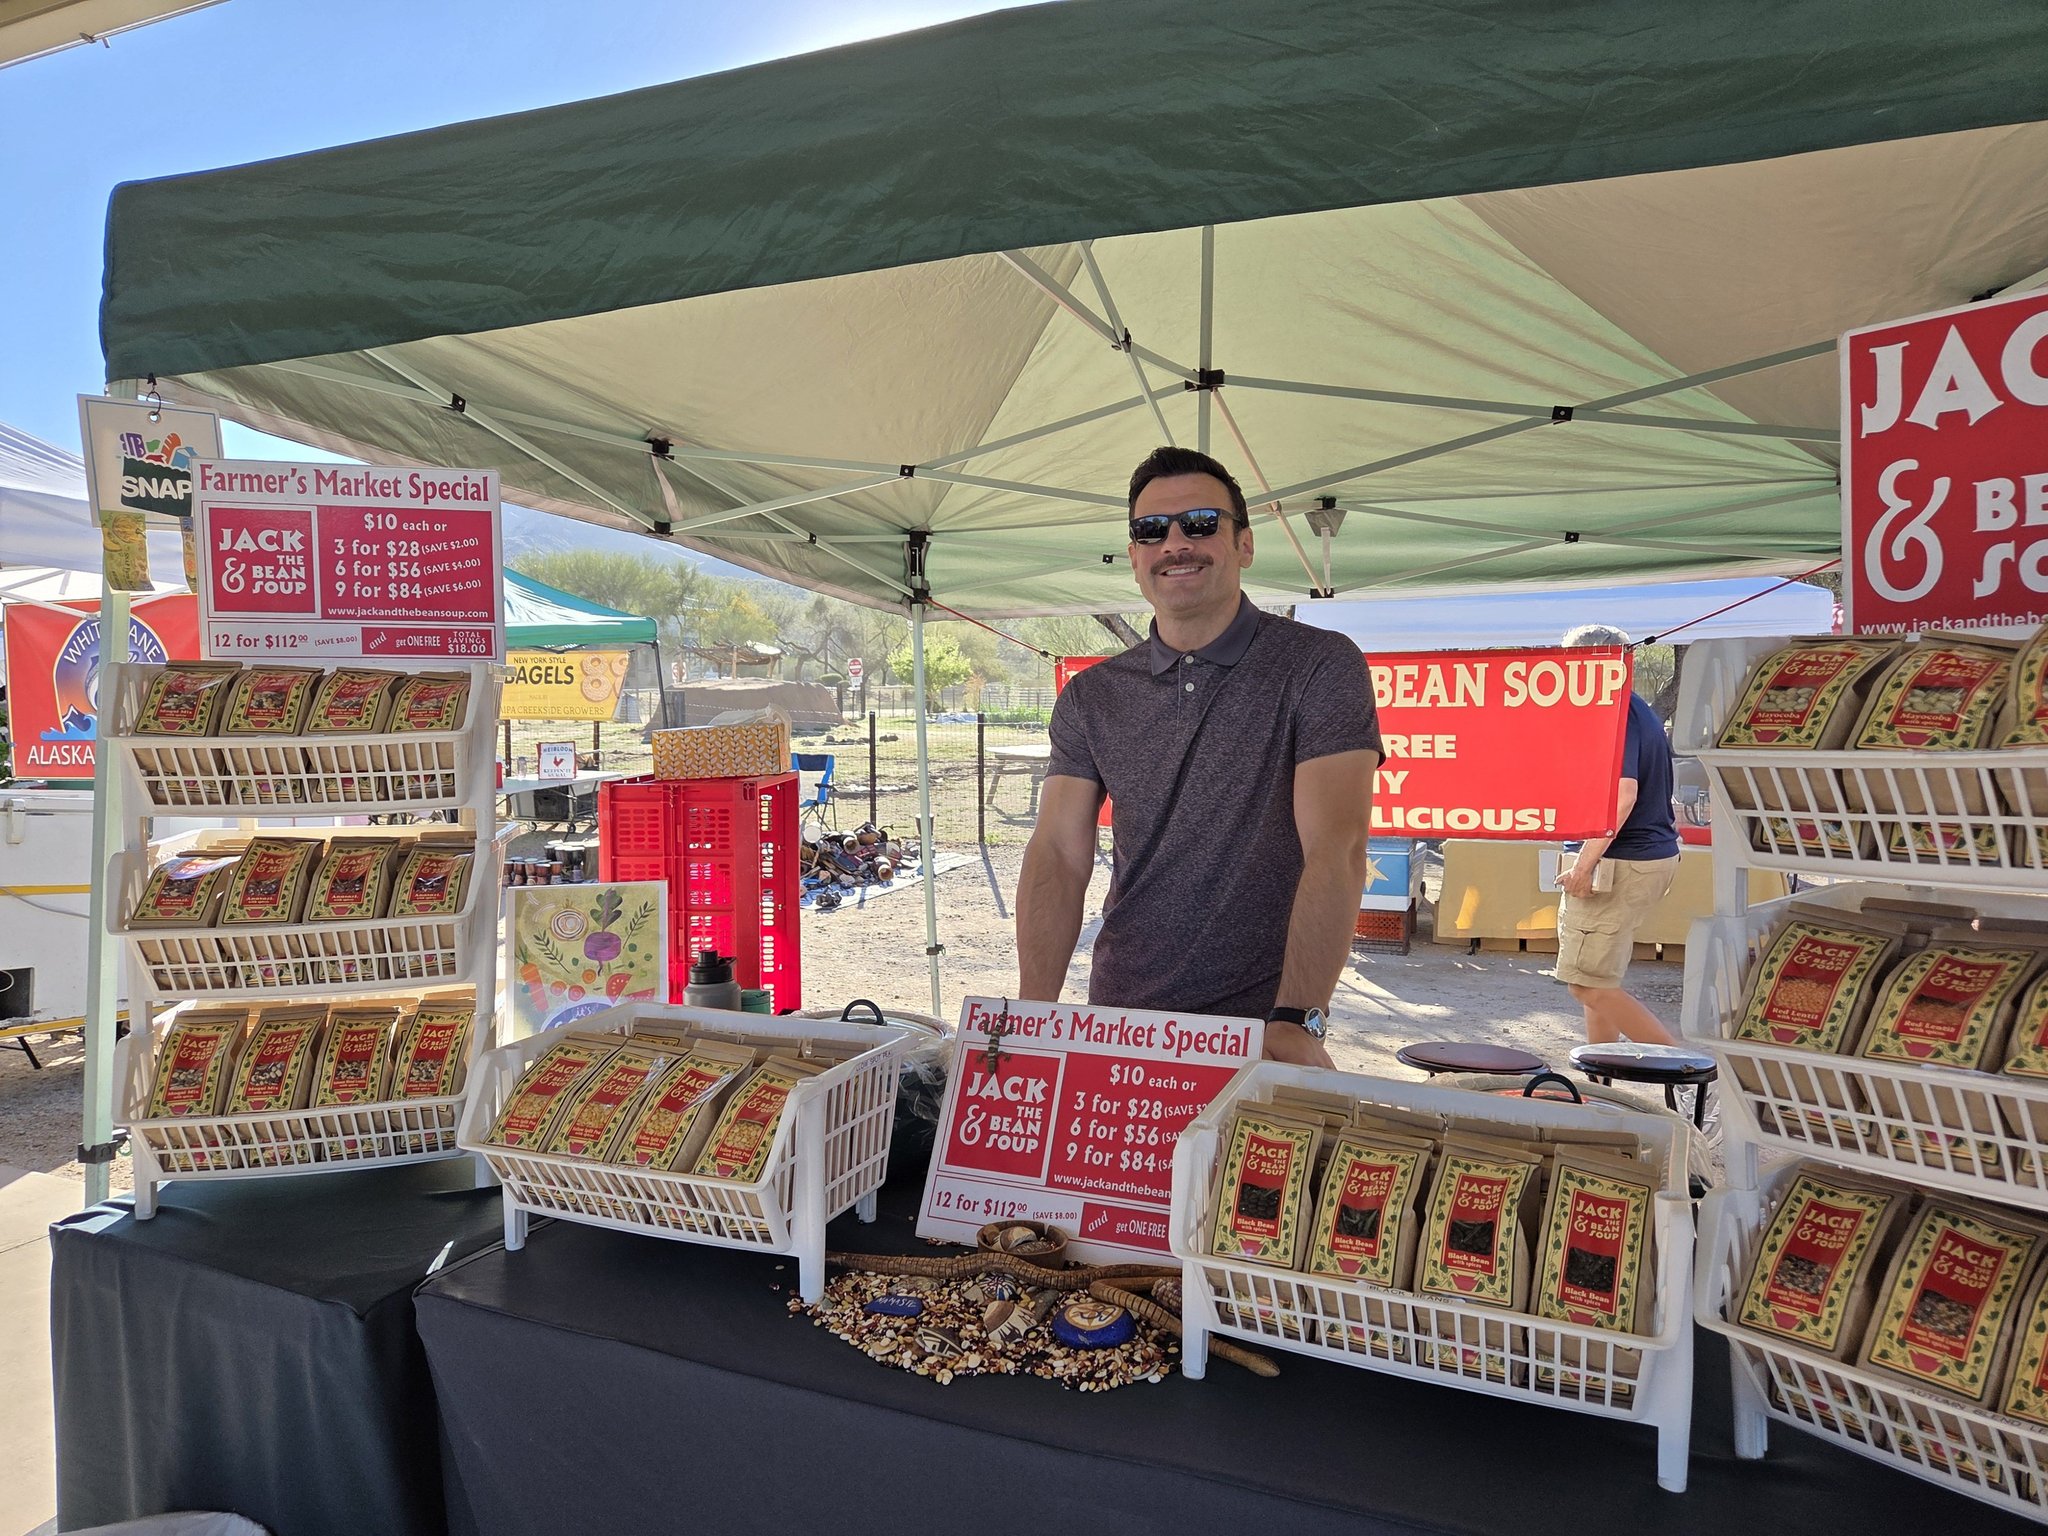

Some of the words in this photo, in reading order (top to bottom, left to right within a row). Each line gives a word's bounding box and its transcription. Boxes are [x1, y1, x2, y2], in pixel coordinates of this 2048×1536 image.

[122, 476, 192, 500] SNAP
[200, 464, 307, 494] Farmer's
[314, 469, 402, 499] Market
[408, 472, 489, 505] Special
[1972, 473, 2048, 533] BE
[364, 512, 398, 532] $10
[402, 520, 430, 532] each
[433, 523, 448, 532] or
[1865, 458, 1951, 602] &
[219, 528, 305, 553] JACK
[334, 538, 345, 555] 3
[352, 539, 380, 556] for
[386, 540, 420, 558] $28
[421, 542, 449, 555] (SAVE
[450, 537, 479, 550] $2.00)
[277, 555, 304, 565] THE
[221, 557, 246, 593] &
[252, 565, 305, 579] BEAN
[335, 560, 347, 576] 6
[353, 560, 381, 577] for
[387, 561, 421, 579] $56
[423, 563, 450, 576] (SAVE
[452, 558, 481, 571] $4.00)
[1972, 539, 2048, 600] SO
[252, 581, 307, 594] SOUP
[335, 581, 347, 597] 9
[353, 582, 381, 598] for
[388, 582, 422, 600] $84
[424, 584, 451, 597] (SAVE
[453, 579, 482, 592] $6.00)
[328, 606, 489, 618] www.jackandthebeansoup.com
[64, 621, 100, 664] WHIT
[129, 625, 161, 663] ANE
[215, 633, 231, 647] 12
[236, 634, 260, 648] for
[369, 631, 387, 650] and
[407, 635, 423, 646] ONE
[424, 636, 441, 647] FREE
[448, 644, 486, 654] $18.00
[514, 656, 528, 664] NEW
[1794, 653, 1847, 662] JACK
[1369, 663, 1489, 708] BEAN
[1503, 659, 1628, 708] SOUP
[563, 706, 605, 715] GROWERS
[1900, 713, 1952, 722] Mayocoba
[1380, 734, 1457, 759] REE
[1371, 806, 1558, 833] LICIOUS!
[1793, 952, 1812, 964] &
[1801, 942, 1854, 958] JACK
[1809, 963, 1843, 971] SOUP
[1939, 963, 1995, 978] JACK
[1772, 1007, 1789, 1015] Red
[1791, 1010, 1818, 1020] Lentil
[345, 1032, 375, 1042] JACK
[424, 1028, 453, 1038] JACK
[966, 1003, 1063, 1039] Farmer's
[1068, 1011, 1157, 1049] Market
[1162, 1018, 1251, 1058] Special
[551, 1063, 581, 1074] JACK
[1109, 1064, 1144, 1086] $10
[1149, 1076, 1177, 1089] each
[1182, 1081, 1197, 1091] or
[967, 1072, 1048, 1103] JACK
[1017, 1106, 1043, 1119] THE
[1074, 1091, 1086, 1110] 3
[1091, 1094, 1120, 1114] for
[1127, 1098, 1162, 1119] $28
[1164, 1105, 1194, 1118] (SAVE
[960, 1104, 987, 1146] &
[989, 1115, 1042, 1136] BEAN
[1070, 1117, 1081, 1136] 6
[1088, 1119, 1117, 1140] for
[1124, 1124, 1159, 1146] $56
[1162, 1132, 1182, 1144] (SA
[986, 1133, 1039, 1154] SOUP
[1250, 1143, 1288, 1159] JACK
[1066, 1142, 1078, 1161] 9
[1084, 1145, 1113, 1167] for
[1120, 1149, 1156, 1172] $84
[1247, 1155, 1260, 1170] &
[1261, 1160, 1286, 1170] BEAN
[1259, 1167, 1285, 1176] SOUP
[1351, 1168, 1391, 1183] JACK
[1054, 1173, 1171, 1199] www.jackandthebean
[1347, 1180, 1361, 1195] &
[1360, 1190, 1386, 1198] SOUP
[1362, 1184, 1387, 1193] BEAN
[1460, 1181, 1503, 1195] JACK
[935, 1190, 951, 1207] 12
[956, 1194, 979, 1212] for
[1032, 1210, 1054, 1220] (SAVE
[1055, 1211, 1078, 1220] $8.00)
[1458, 1193, 1471, 1208] &
[1471, 1202, 1499, 1211] SOUP
[1576, 1199, 1623, 1219] JACK
[1088, 1211, 1109, 1232] and
[1115, 1222, 1128, 1233] get
[1129, 1220, 1148, 1236] ONE
[1149, 1222, 1167, 1239] FREE
[1236, 1218, 1256, 1226] Black
[1257, 1220, 1275, 1229] Bean
[1573, 1215, 1588, 1233] &
[1804, 1208, 1855, 1229] JACK
[1589, 1230, 1619, 1240] SOUP
[1591, 1222, 1620, 1232] BEAN
[1797, 1223, 1816, 1240] &
[1335, 1237, 1355, 1245] Black
[1356, 1239, 1374, 1248] Bean
[1812, 1238, 1844, 1249] SOUP
[1816, 1231, 1847, 1242] BEAN
[1448, 1252, 1469, 1261] Black
[1470, 1255, 1490, 1266] Bean
[1940, 1239, 1998, 1268] JACK
[1933, 1255, 1954, 1275] &
[1950, 1273, 1987, 1289] SOUP
[1954, 1265, 1990, 1282] BEAN
[1565, 1286, 1587, 1297] Black
[1588, 1291, 1610, 1304] Bean
